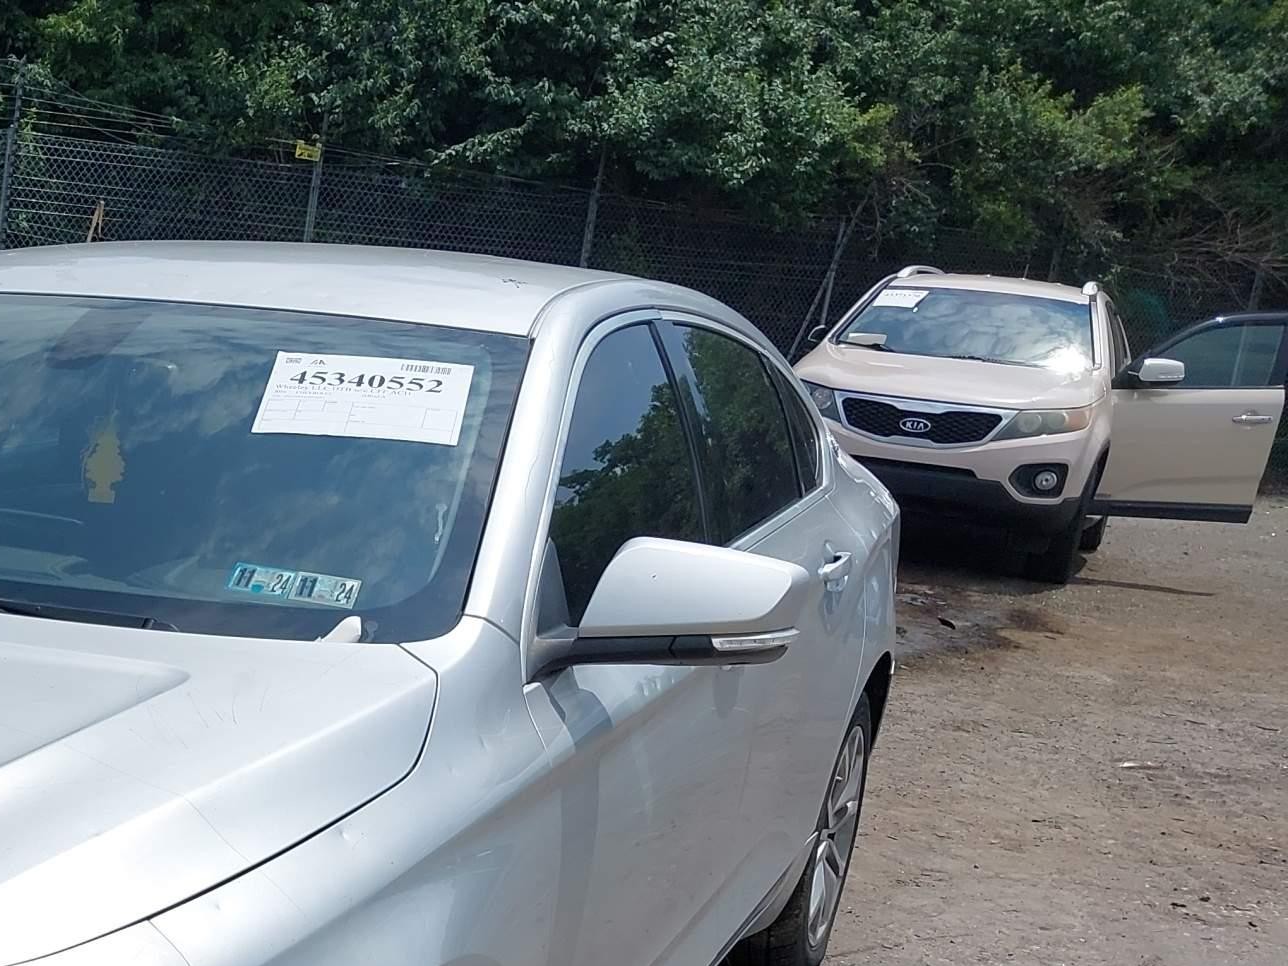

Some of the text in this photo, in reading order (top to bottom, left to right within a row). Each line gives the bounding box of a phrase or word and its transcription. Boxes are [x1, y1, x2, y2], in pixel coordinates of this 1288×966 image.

[290, 370, 443, 393] 45340552
[905, 422, 924, 430] KIA
[235, 567, 292, 594] 11 24
[296, 575, 355, 604] 11 24
